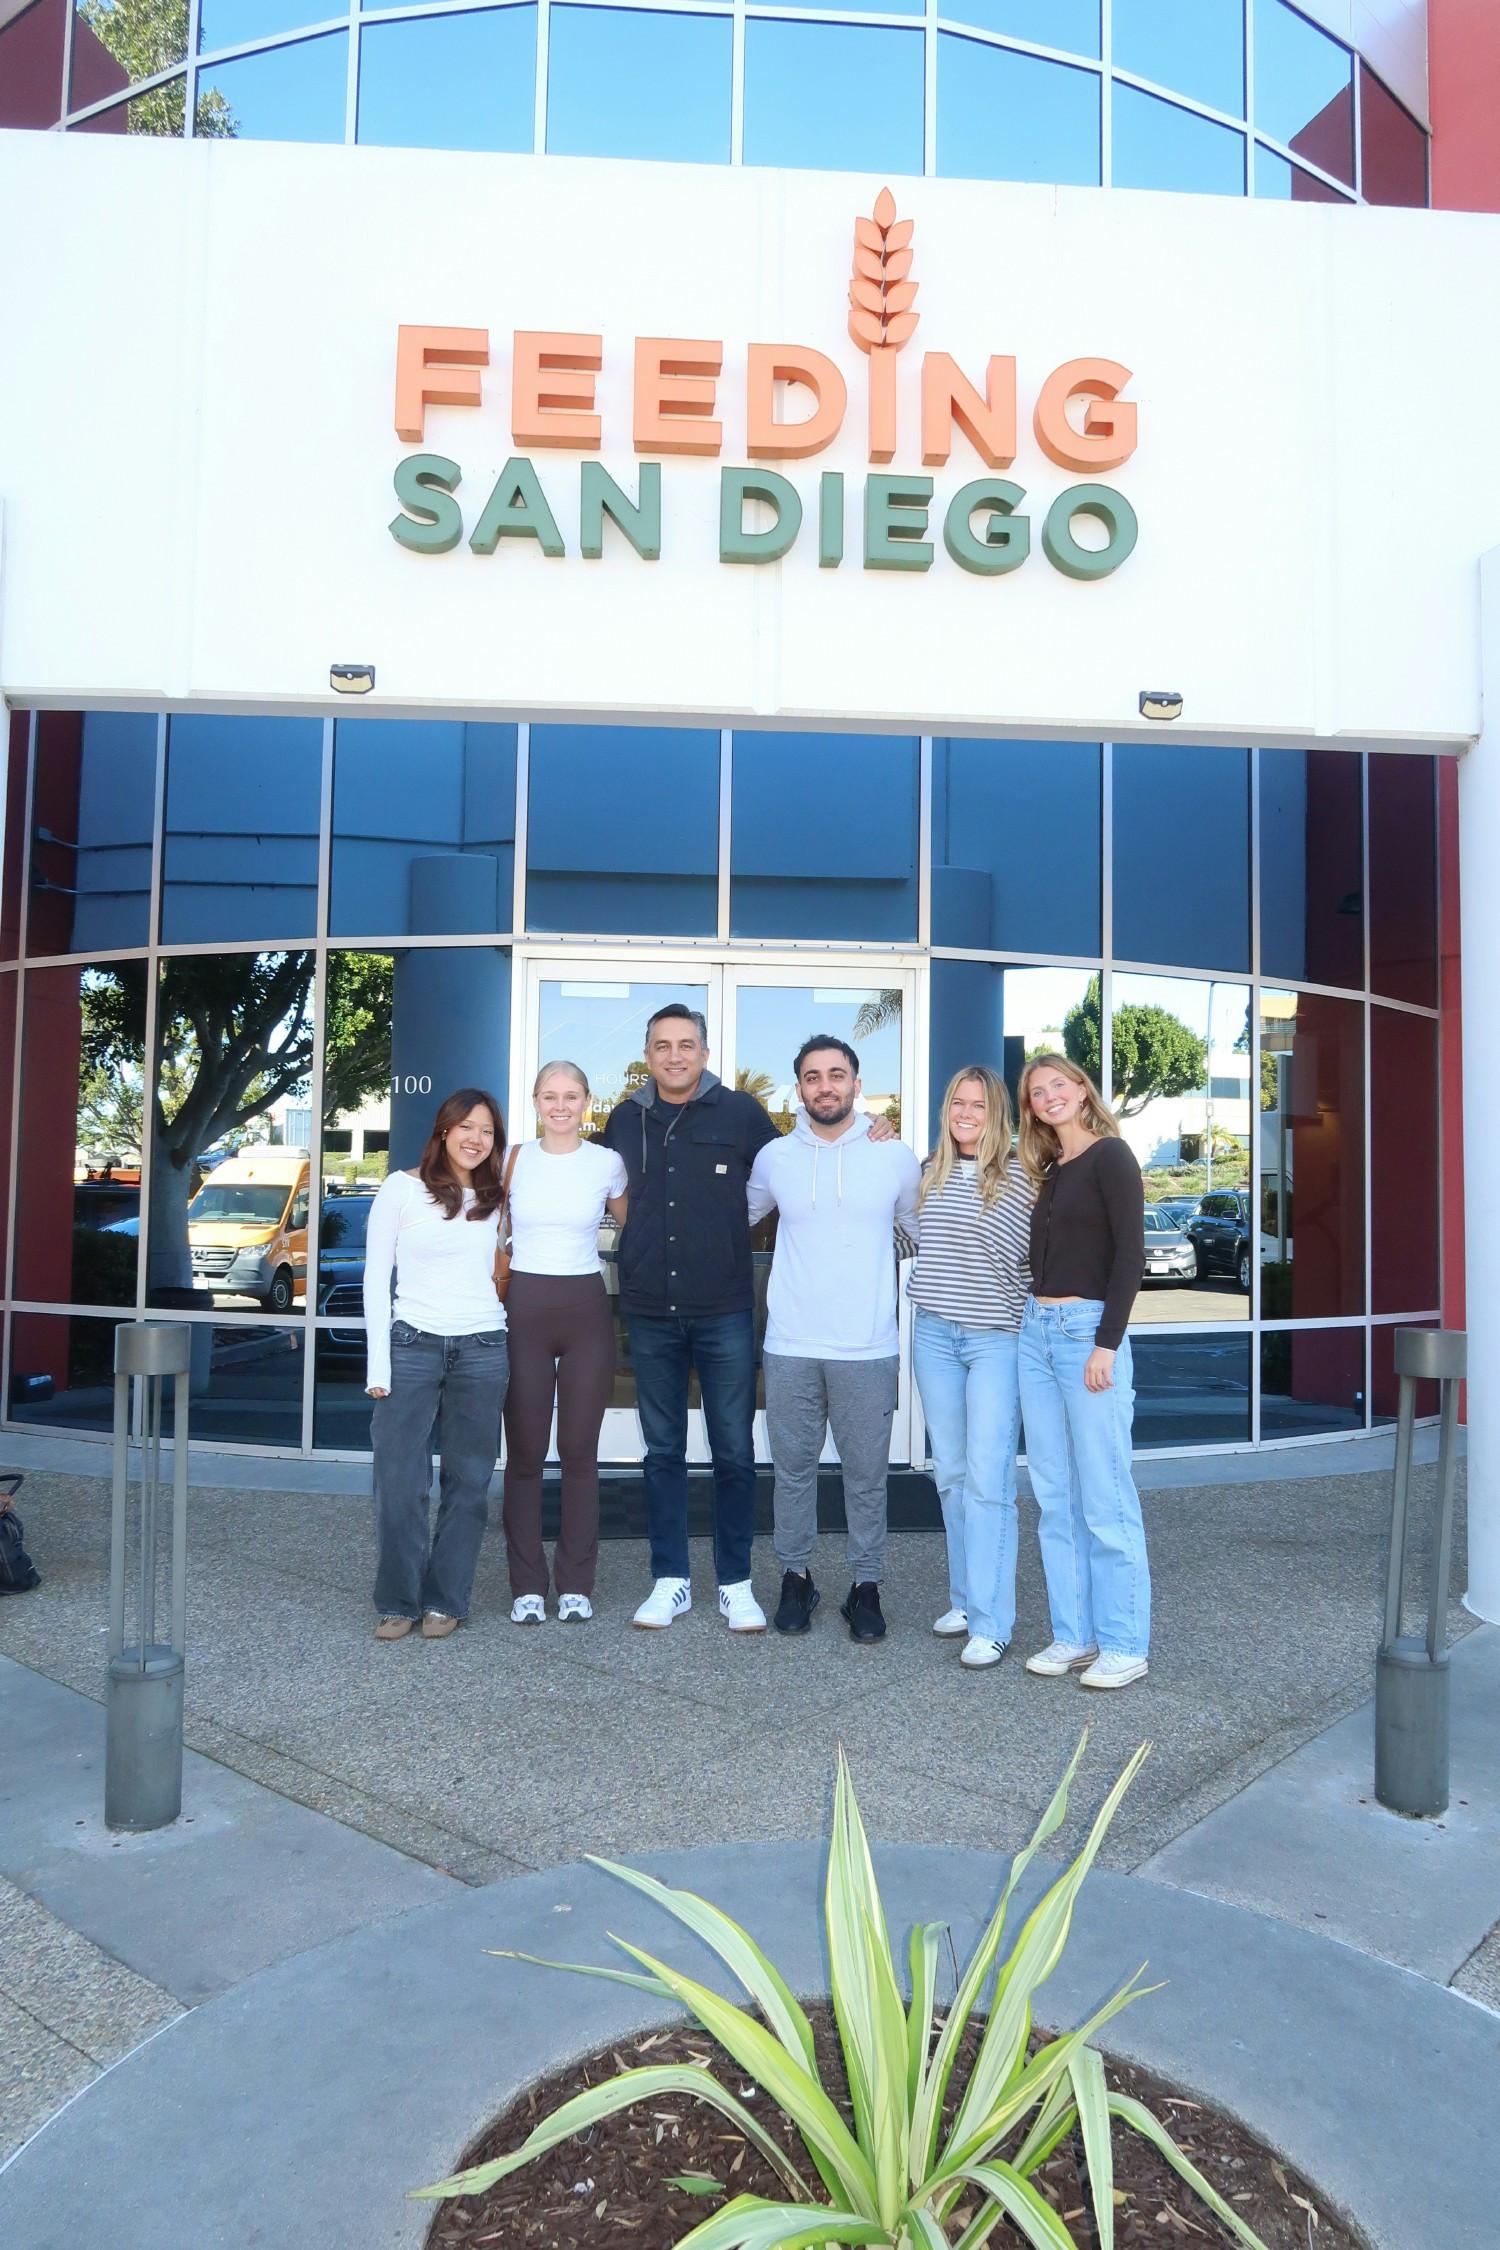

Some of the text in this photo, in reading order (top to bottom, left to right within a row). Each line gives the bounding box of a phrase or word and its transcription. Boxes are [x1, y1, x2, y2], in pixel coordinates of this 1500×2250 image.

[394, 323, 1138, 473] FEEDING
[388, 453, 1139, 581] SAN DIEGO
[391, 1075, 432, 1094] 100
[595, 1073, 649, 1086] HOURS
